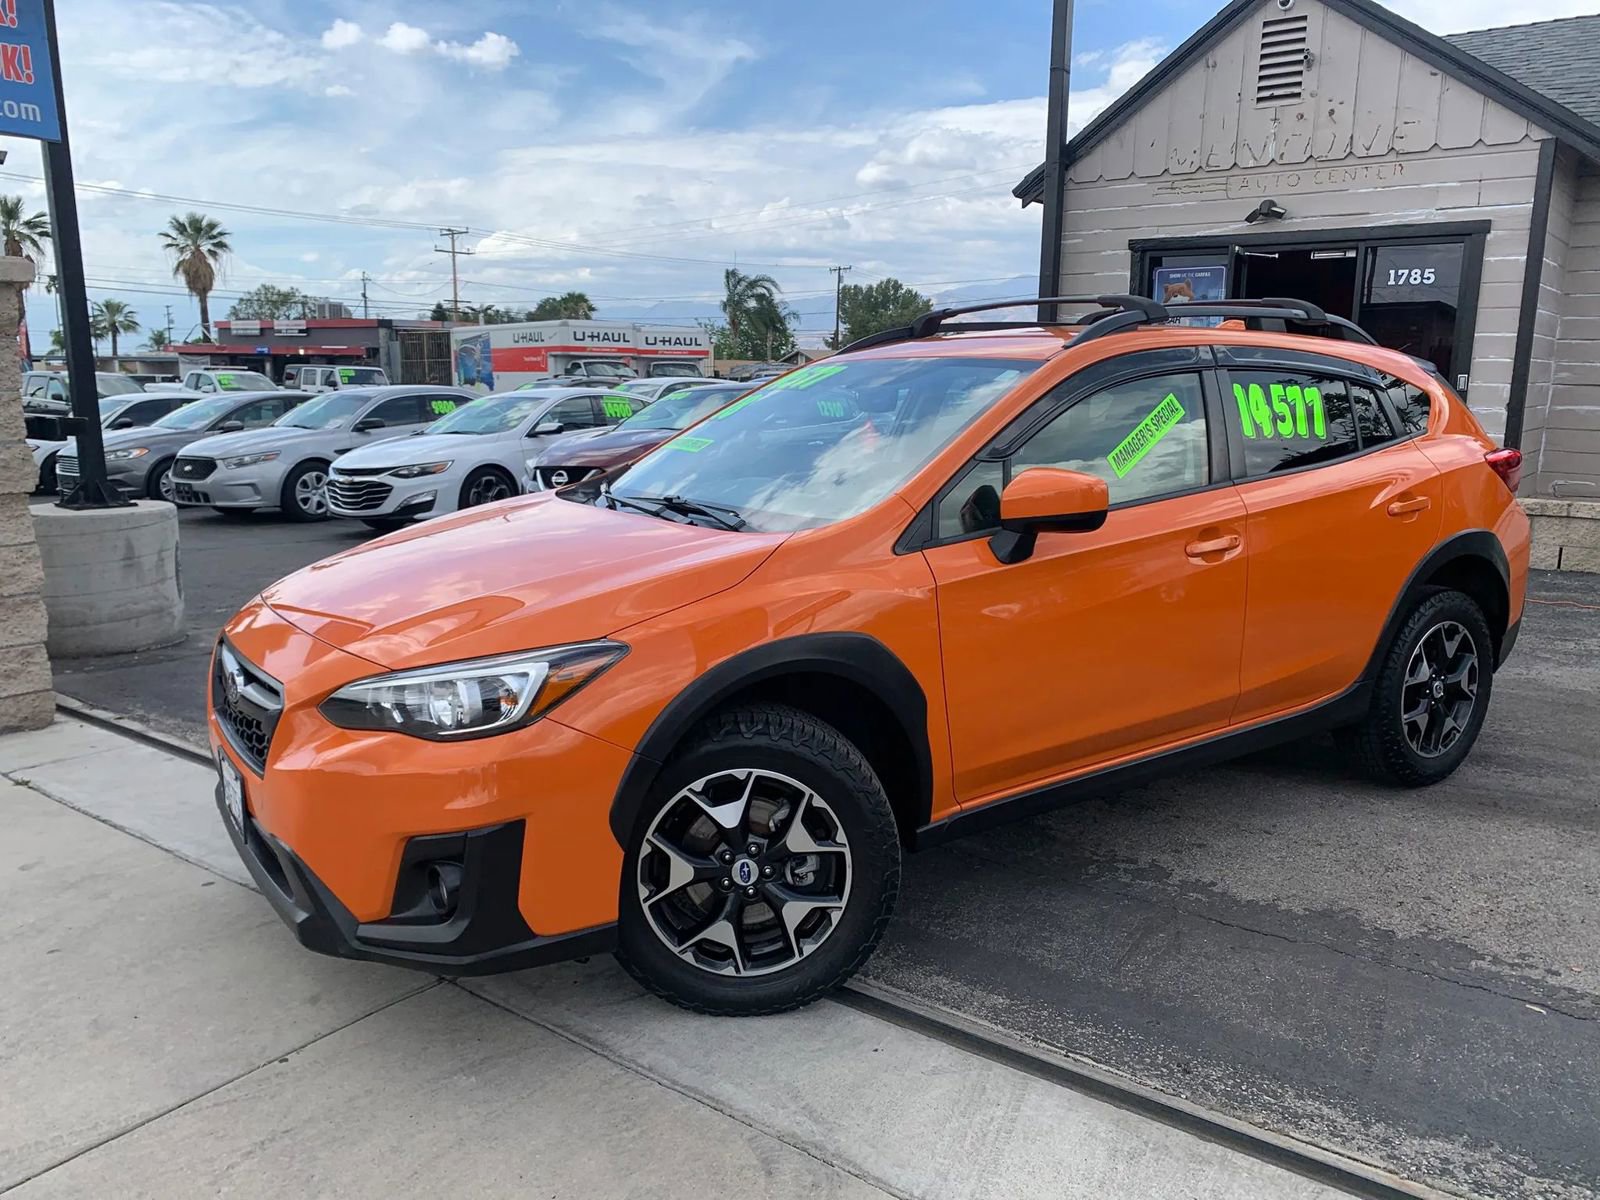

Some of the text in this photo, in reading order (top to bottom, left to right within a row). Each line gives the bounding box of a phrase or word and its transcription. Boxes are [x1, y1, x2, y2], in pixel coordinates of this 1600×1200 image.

[1387, 268, 1436, 286] 1785
[572, 330, 631, 344] U-HAUL
[645, 335, 702, 347] U-HAUL
[1232, 383, 1327, 439] 14577
[1112, 399, 1179, 471] MANAGER'S SPECIAL
